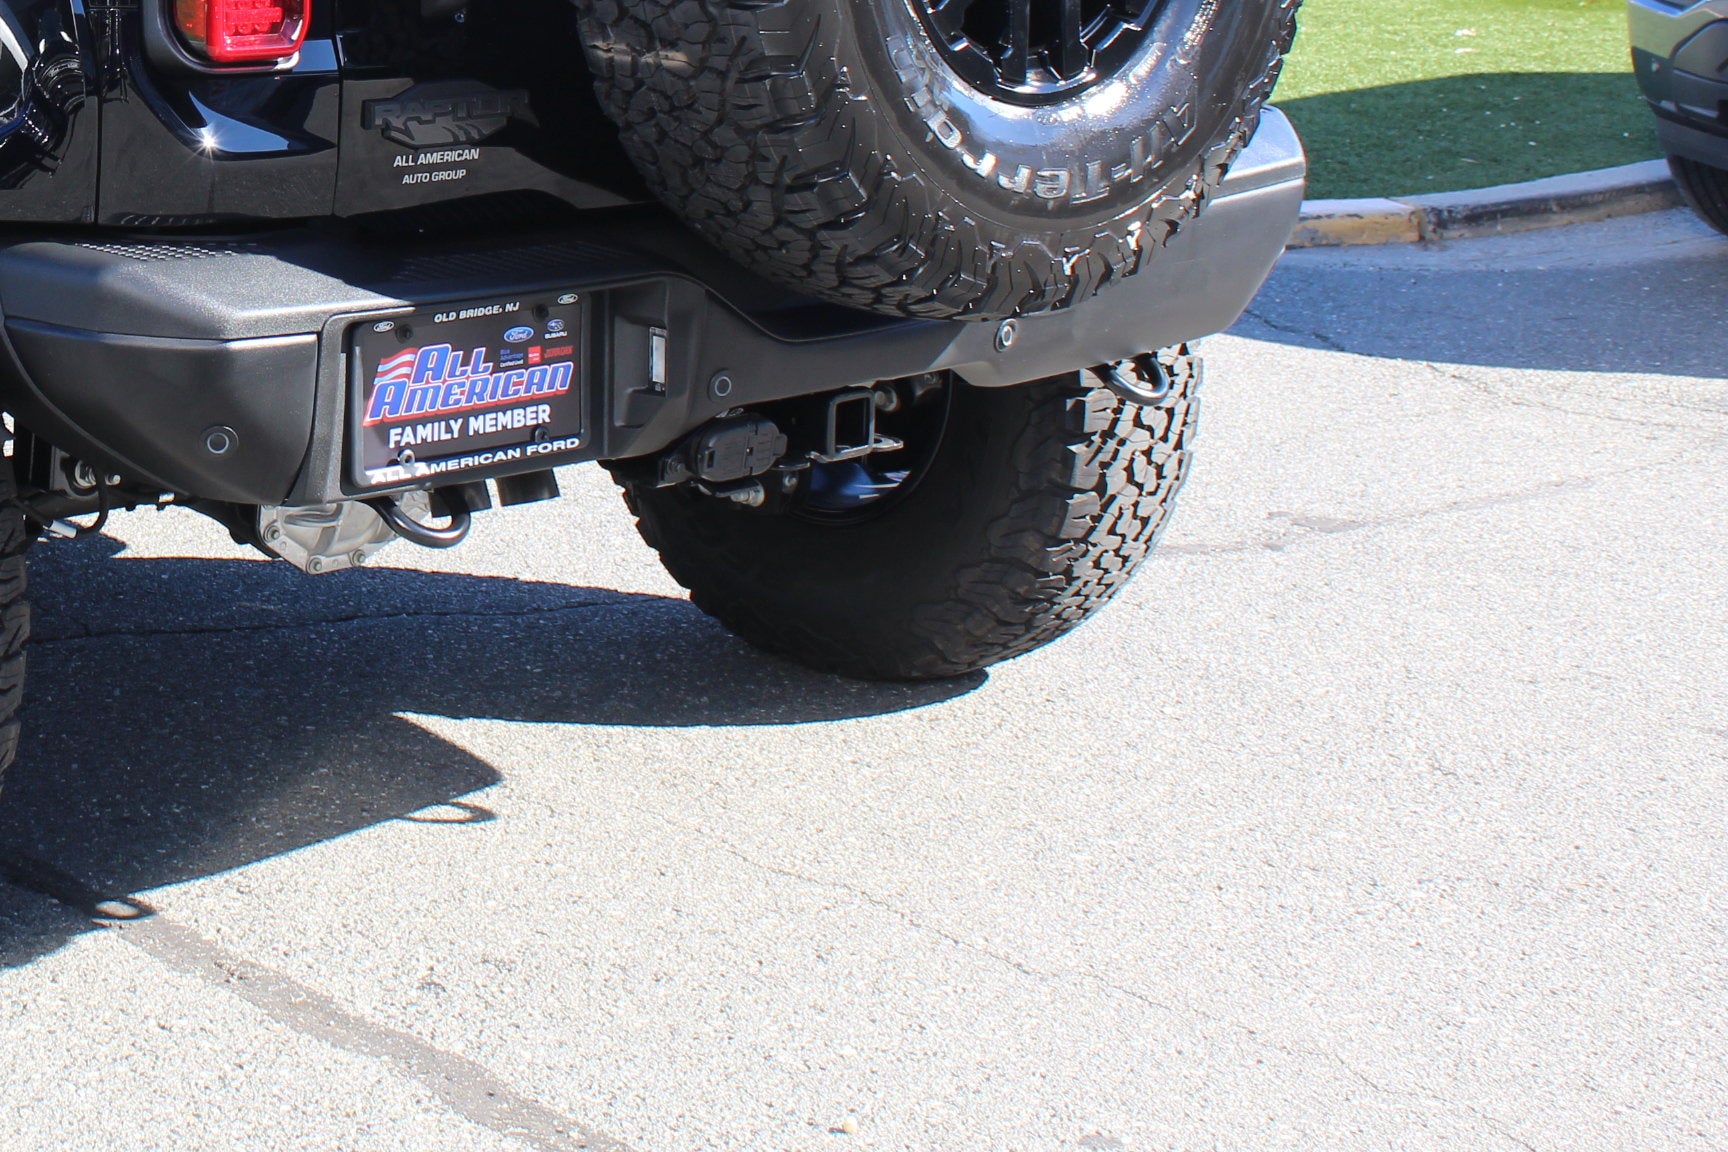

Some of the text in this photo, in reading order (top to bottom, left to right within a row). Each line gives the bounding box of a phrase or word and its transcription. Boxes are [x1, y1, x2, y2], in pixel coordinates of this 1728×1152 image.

[374, 87, 530, 130] RAPTOR
[393, 147, 480, 168] ALL AMERICAN
[402, 168, 467, 184] AUTO GROUP
[434, 301, 520, 323] OLD BRIDGE, NJ
[411, 344, 493, 385] ALL
[365, 361, 574, 422] AMERICAN
[388, 404, 551, 449] FAMILY MEMBER
[370, 437, 580, 484] ALL AMERICAN FORD
